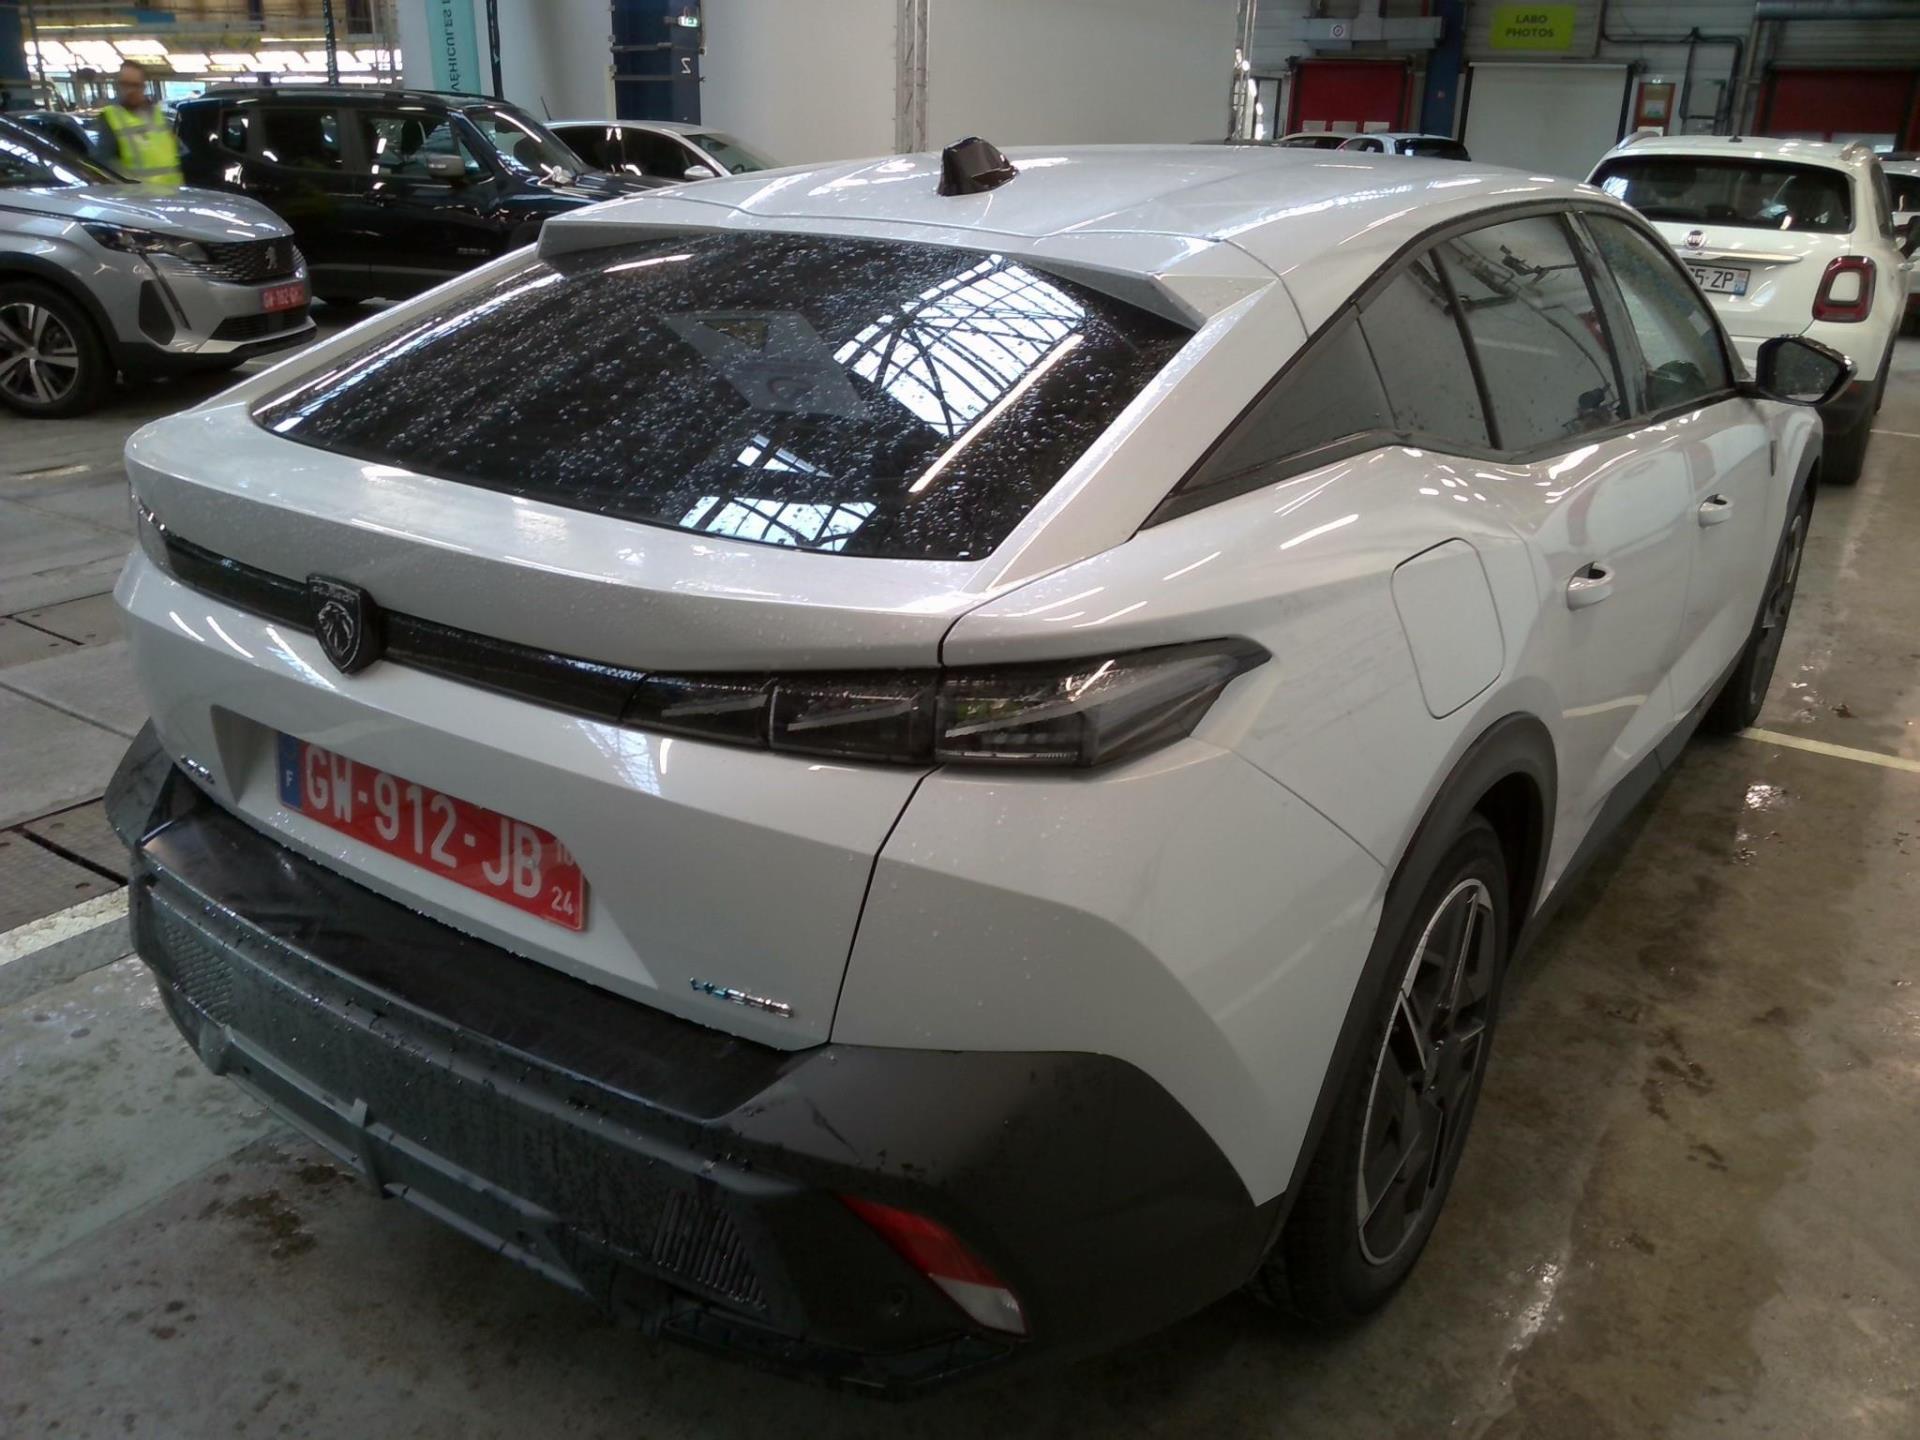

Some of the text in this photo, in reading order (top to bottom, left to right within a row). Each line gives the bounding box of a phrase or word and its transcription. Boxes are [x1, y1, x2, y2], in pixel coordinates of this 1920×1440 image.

[1515, 14, 1548, 24] LABO
[1505, 27, 1554, 38] PHOTOS
[286, 769, 294, 788] F
[306, 744, 542, 898] GW-912-JB
[551, 886, 574, 916] 24
